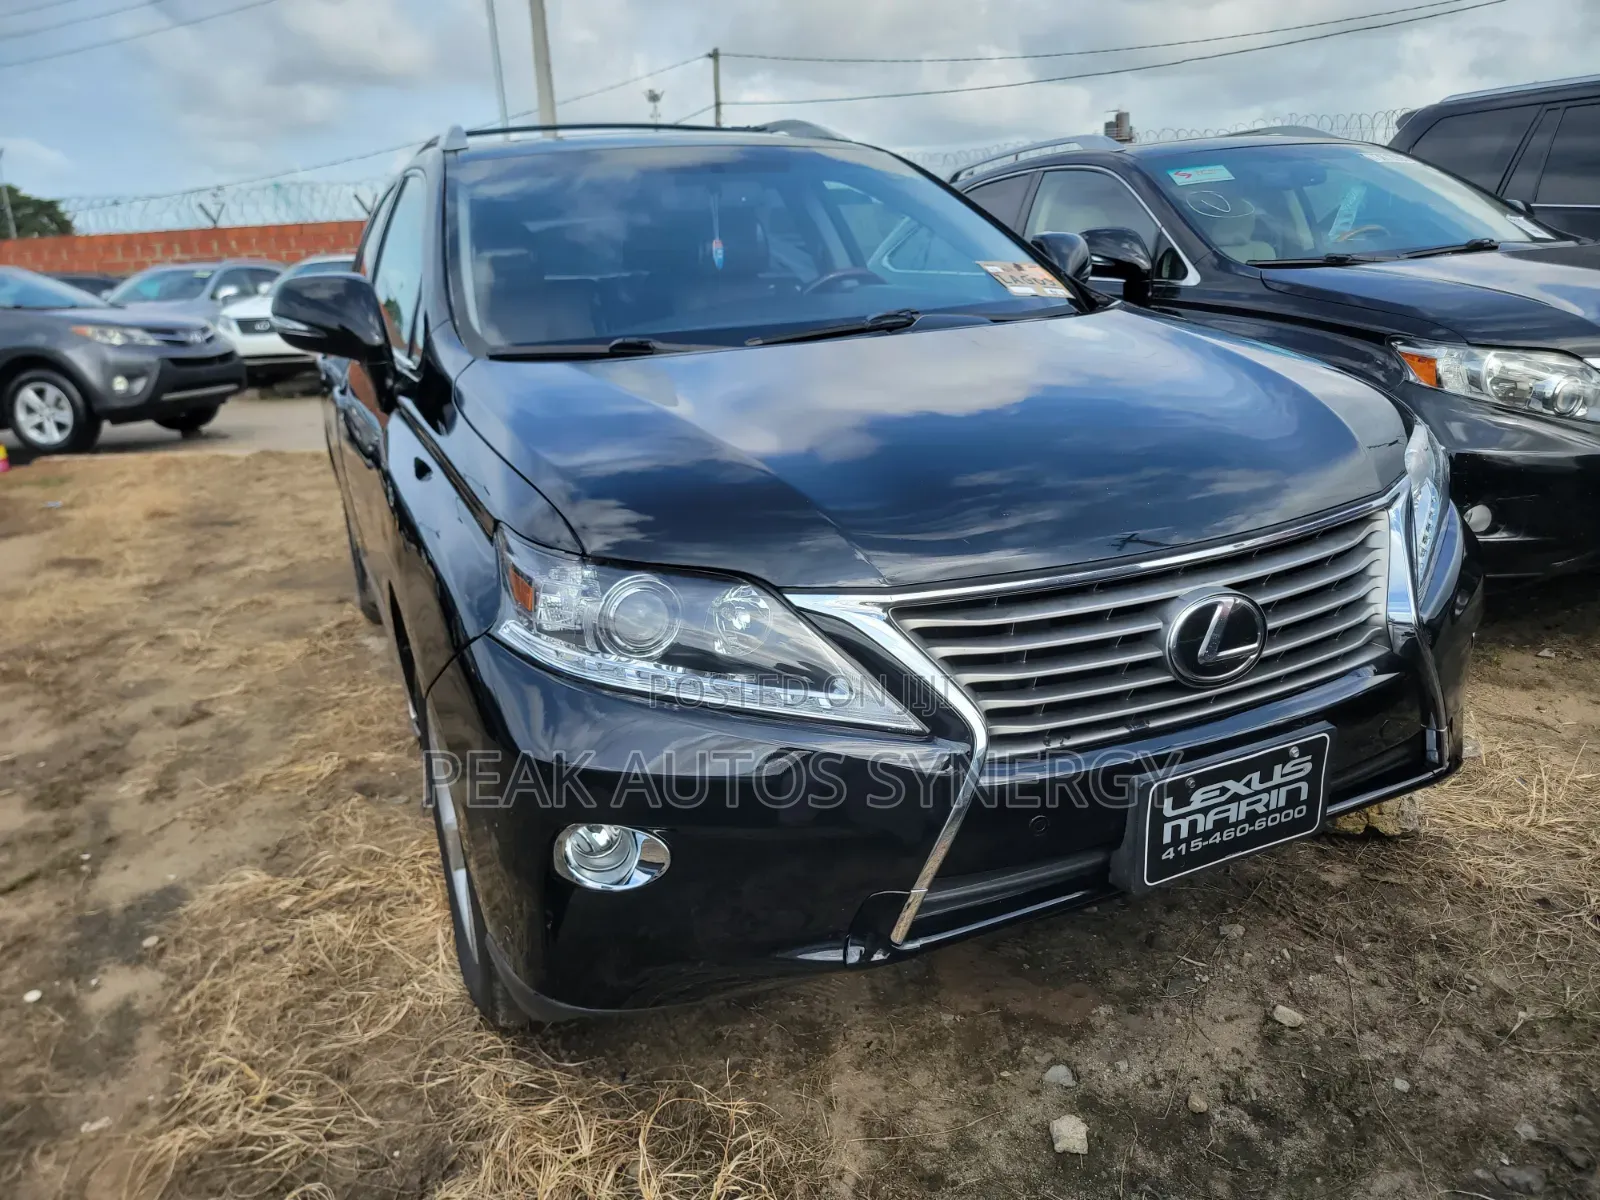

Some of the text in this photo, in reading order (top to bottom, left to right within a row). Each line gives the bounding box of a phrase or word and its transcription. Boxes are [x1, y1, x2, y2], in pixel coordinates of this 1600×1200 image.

[1163, 755, 1312, 817] LEXUS
[1163, 781, 1309, 845] MARIN
[1161, 805, 1307, 860] 415-460-6000
